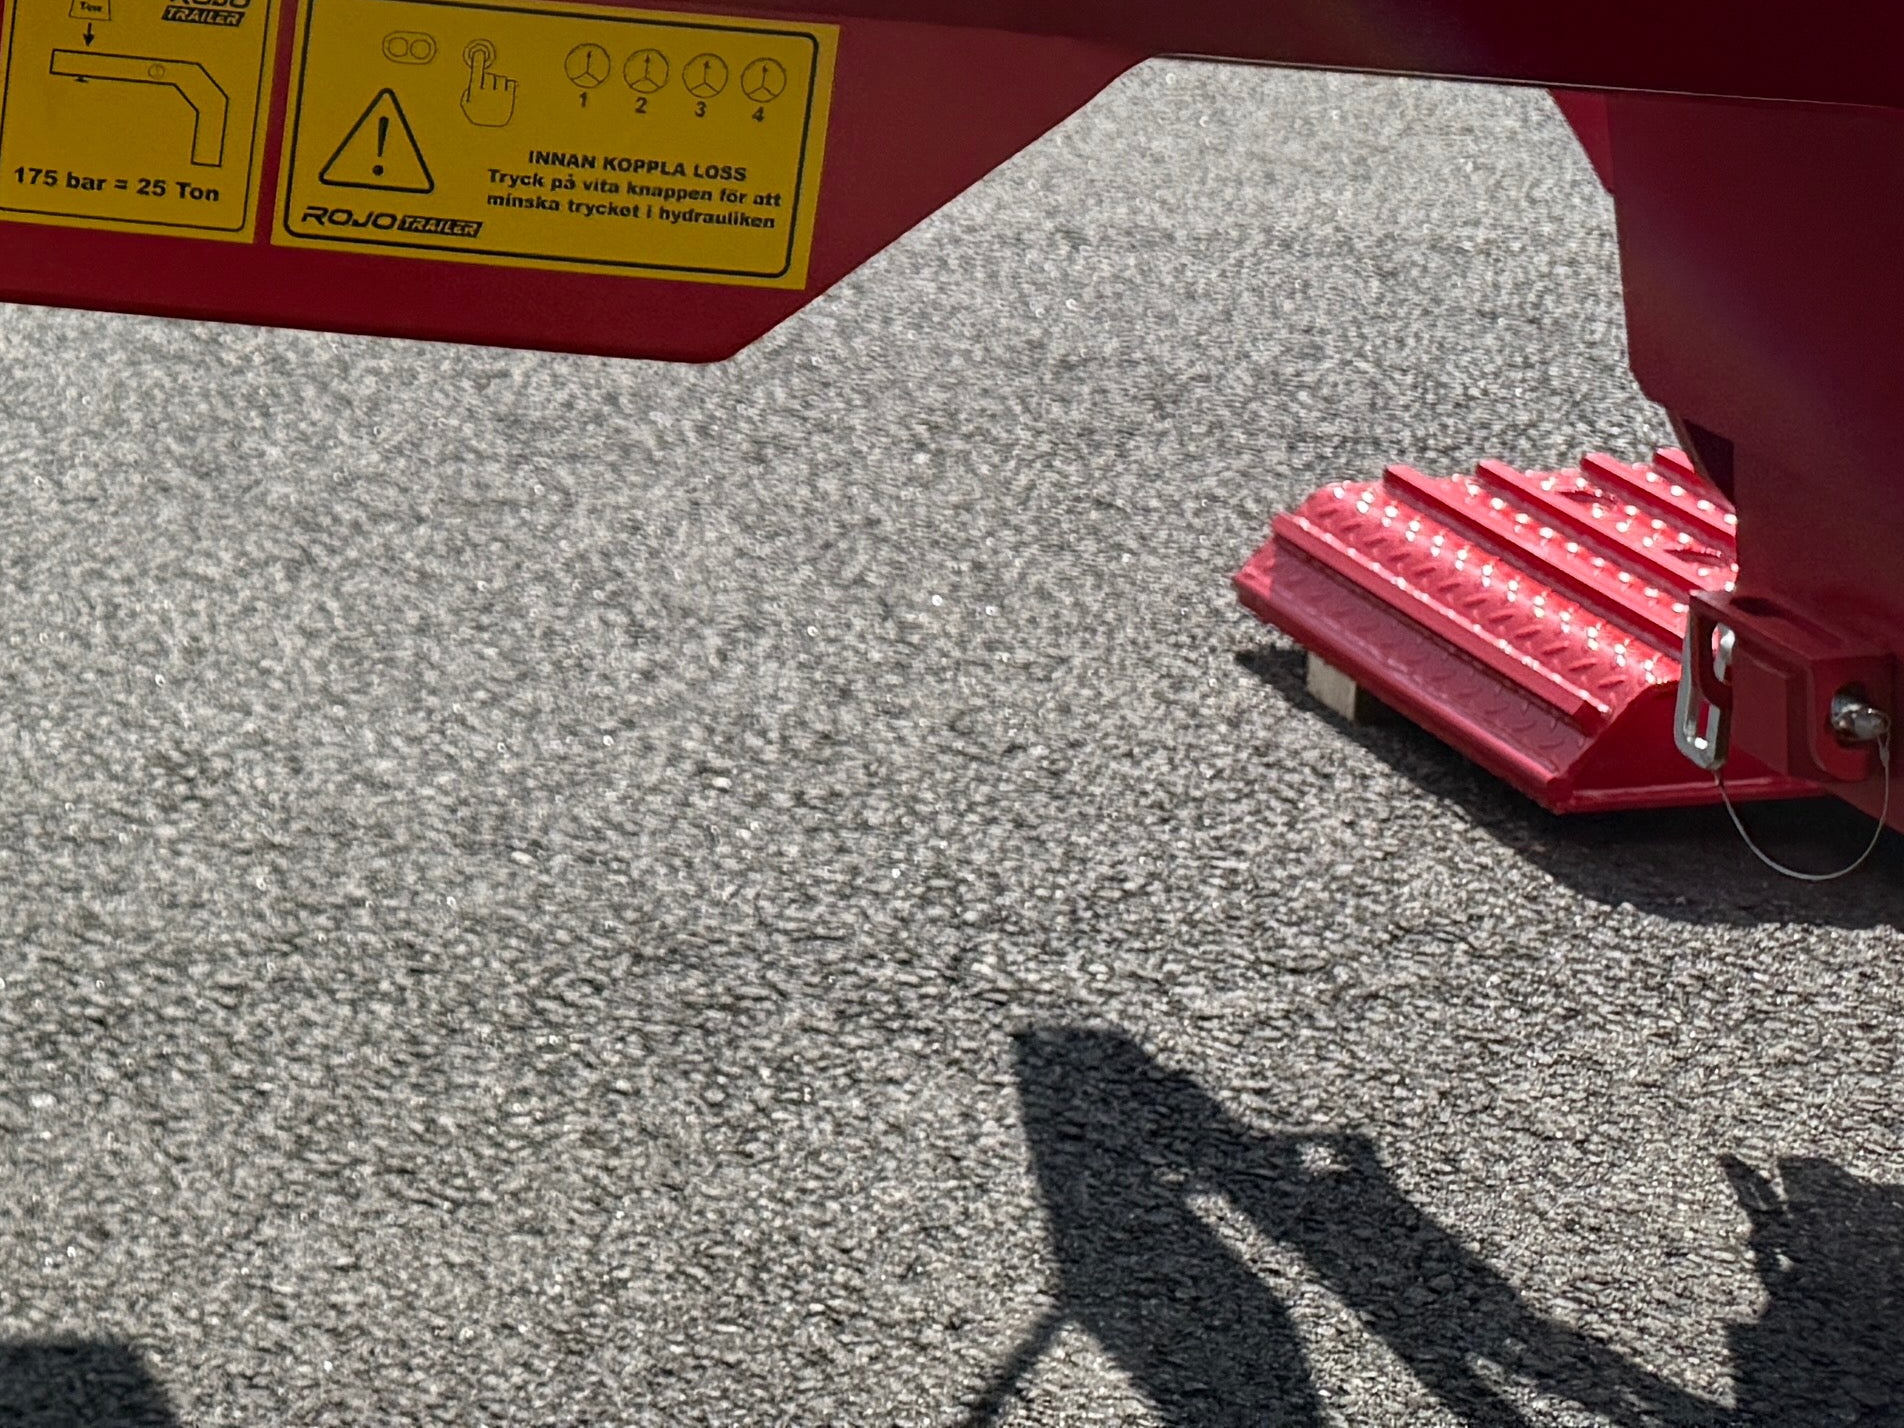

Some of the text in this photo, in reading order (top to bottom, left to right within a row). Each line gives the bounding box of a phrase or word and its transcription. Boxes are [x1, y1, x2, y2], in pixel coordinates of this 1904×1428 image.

[166, 7, 241, 26] TRAILER
[579, 92, 765, 123] 1 2 3 4
[528, 149, 747, 182] INNAN KOPPLA LOSS
[14, 166, 220, 202] 175 bar = 25 Ton
[487, 168, 782, 207] Tryck på vita knappen för att
[301, 205, 481, 237] ROJO TRAILER
[486, 192, 560, 213] minska
[566, 197, 640, 219] trycket
[658, 206, 776, 230] hydrauliken
